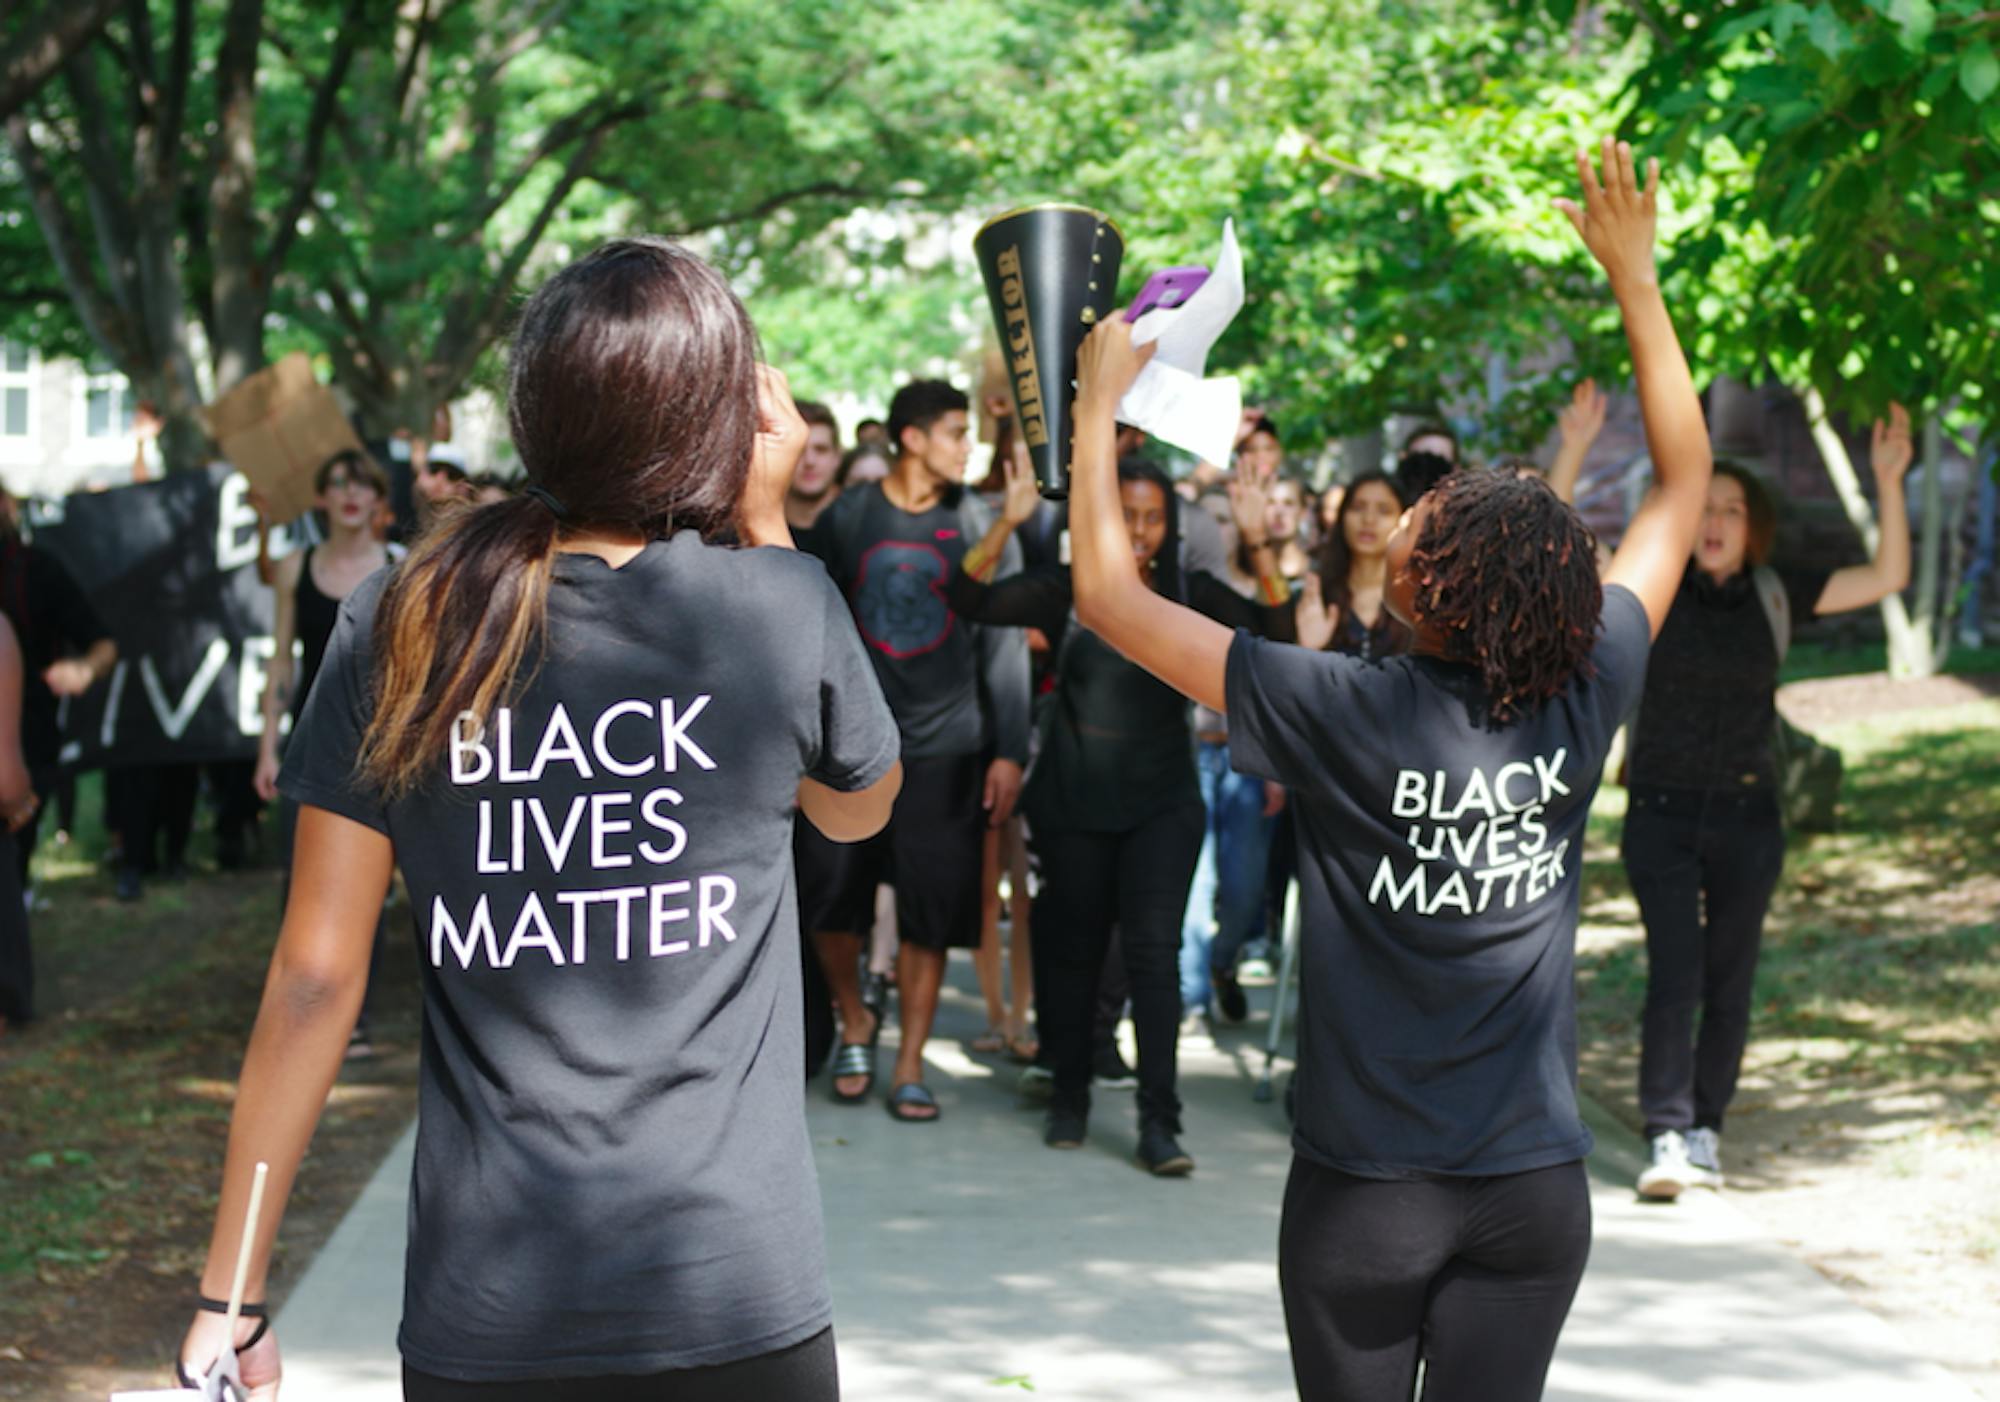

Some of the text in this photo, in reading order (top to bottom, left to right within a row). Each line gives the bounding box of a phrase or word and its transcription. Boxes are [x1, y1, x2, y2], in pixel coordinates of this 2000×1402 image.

[996, 243, 1048, 446] DIRECTOR
[450, 695, 718, 784] BLACK
[1391, 747, 1571, 820] BLACK
[477, 787, 688, 873] LIVES
[1367, 839, 1569, 915] MATTER
[430, 874, 738, 970] MATTER
